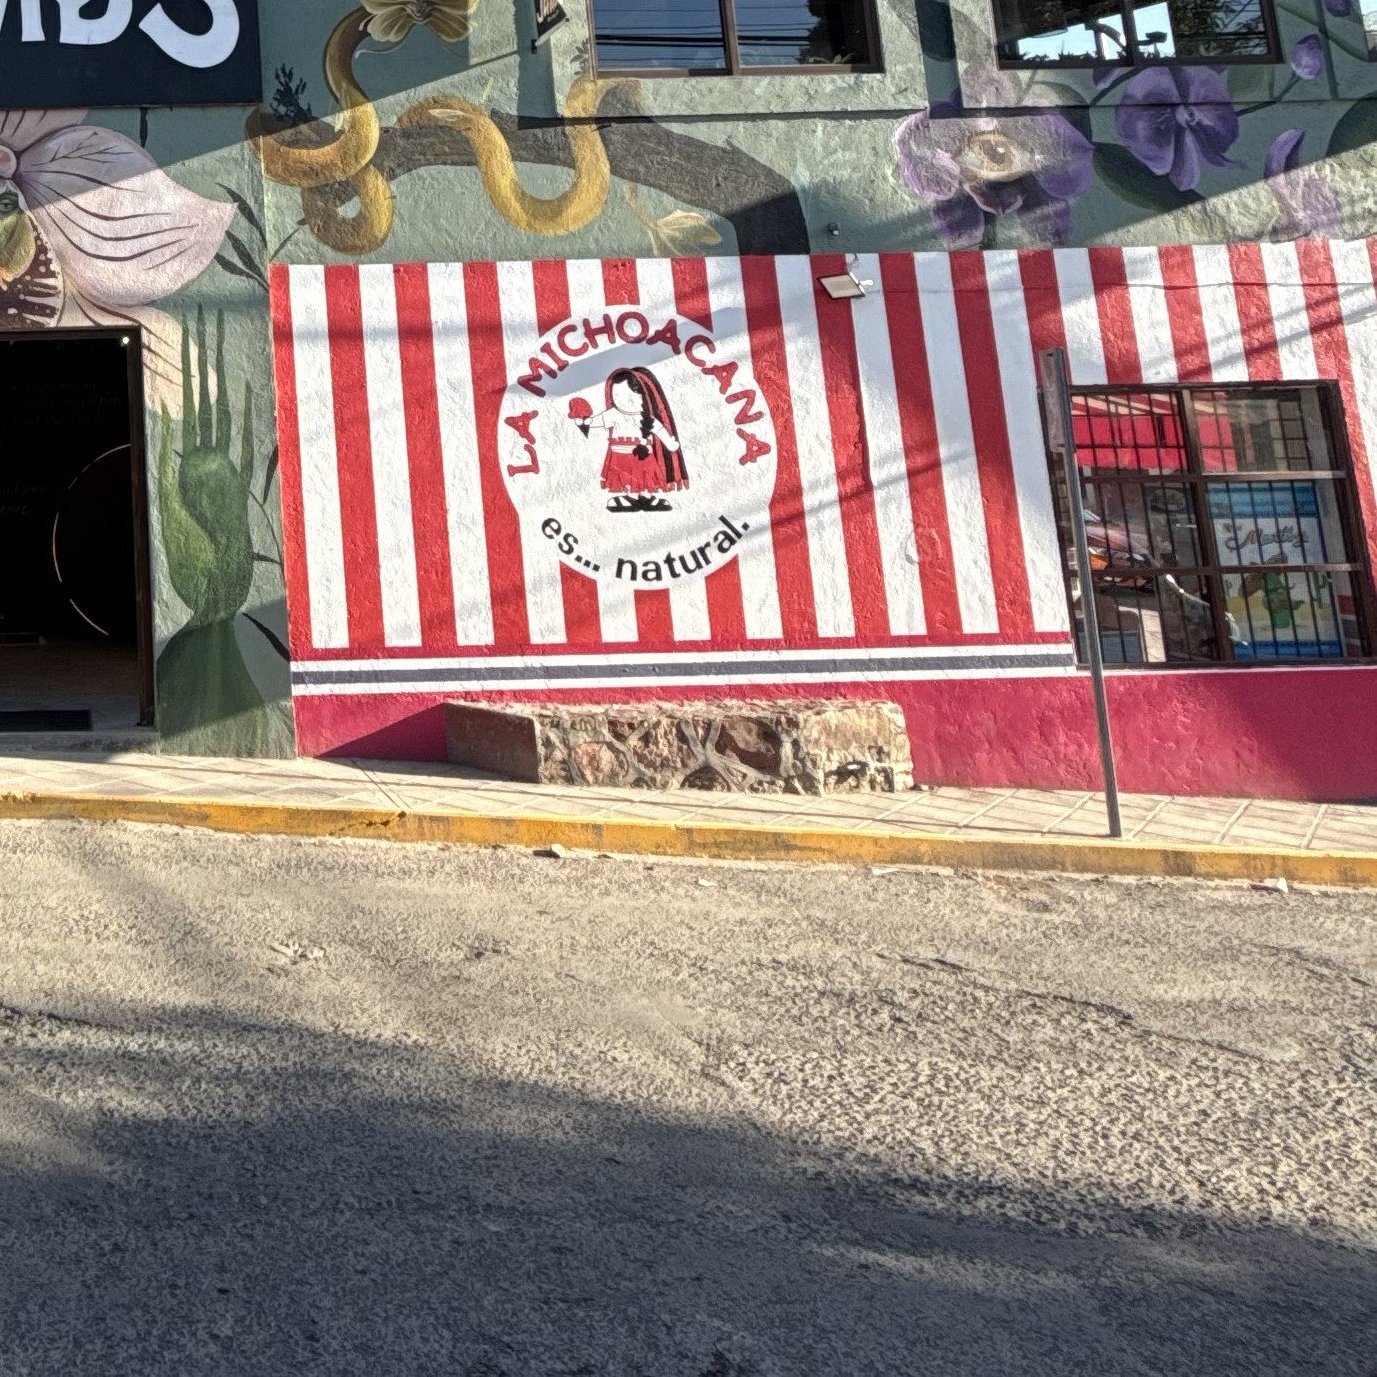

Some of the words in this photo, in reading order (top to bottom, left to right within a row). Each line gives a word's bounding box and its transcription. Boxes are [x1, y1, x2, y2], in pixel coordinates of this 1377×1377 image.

[517, 311, 772, 466] MICHOACANA
[504, 410, 540, 477] LA
[541, 517, 601, 572] es...
[615, 514, 750, 582] natural.
